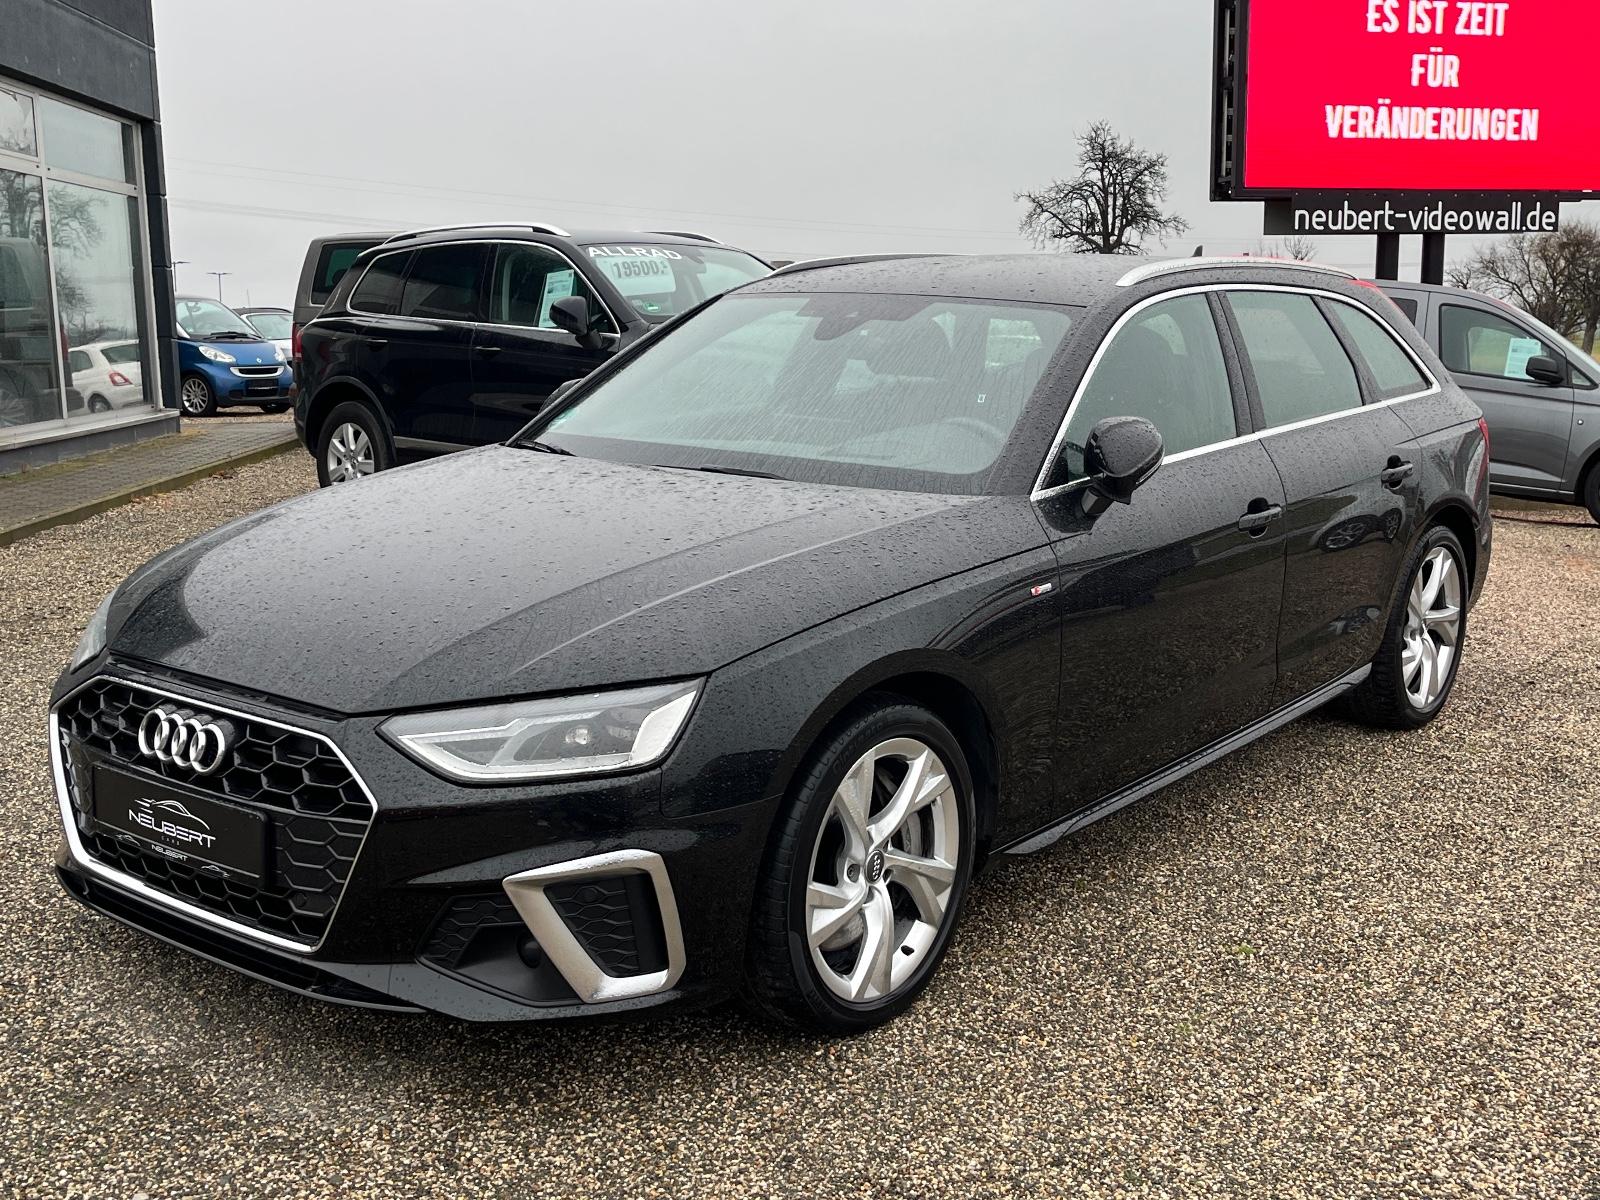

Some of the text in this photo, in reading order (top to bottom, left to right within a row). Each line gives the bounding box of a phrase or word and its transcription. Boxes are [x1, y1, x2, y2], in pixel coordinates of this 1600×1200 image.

[1366, 0, 1510, 37] ES IST ZEIT
[1410, 46, 1461, 88] FÜR
[1324, 97, 1540, 141] VERÄNDERUNGEN
[1294, 200, 1556, 231] neubert-videowall.de
[587, 245, 683, 260] ALLRAD
[128, 808, 217, 848] NEUBERT
